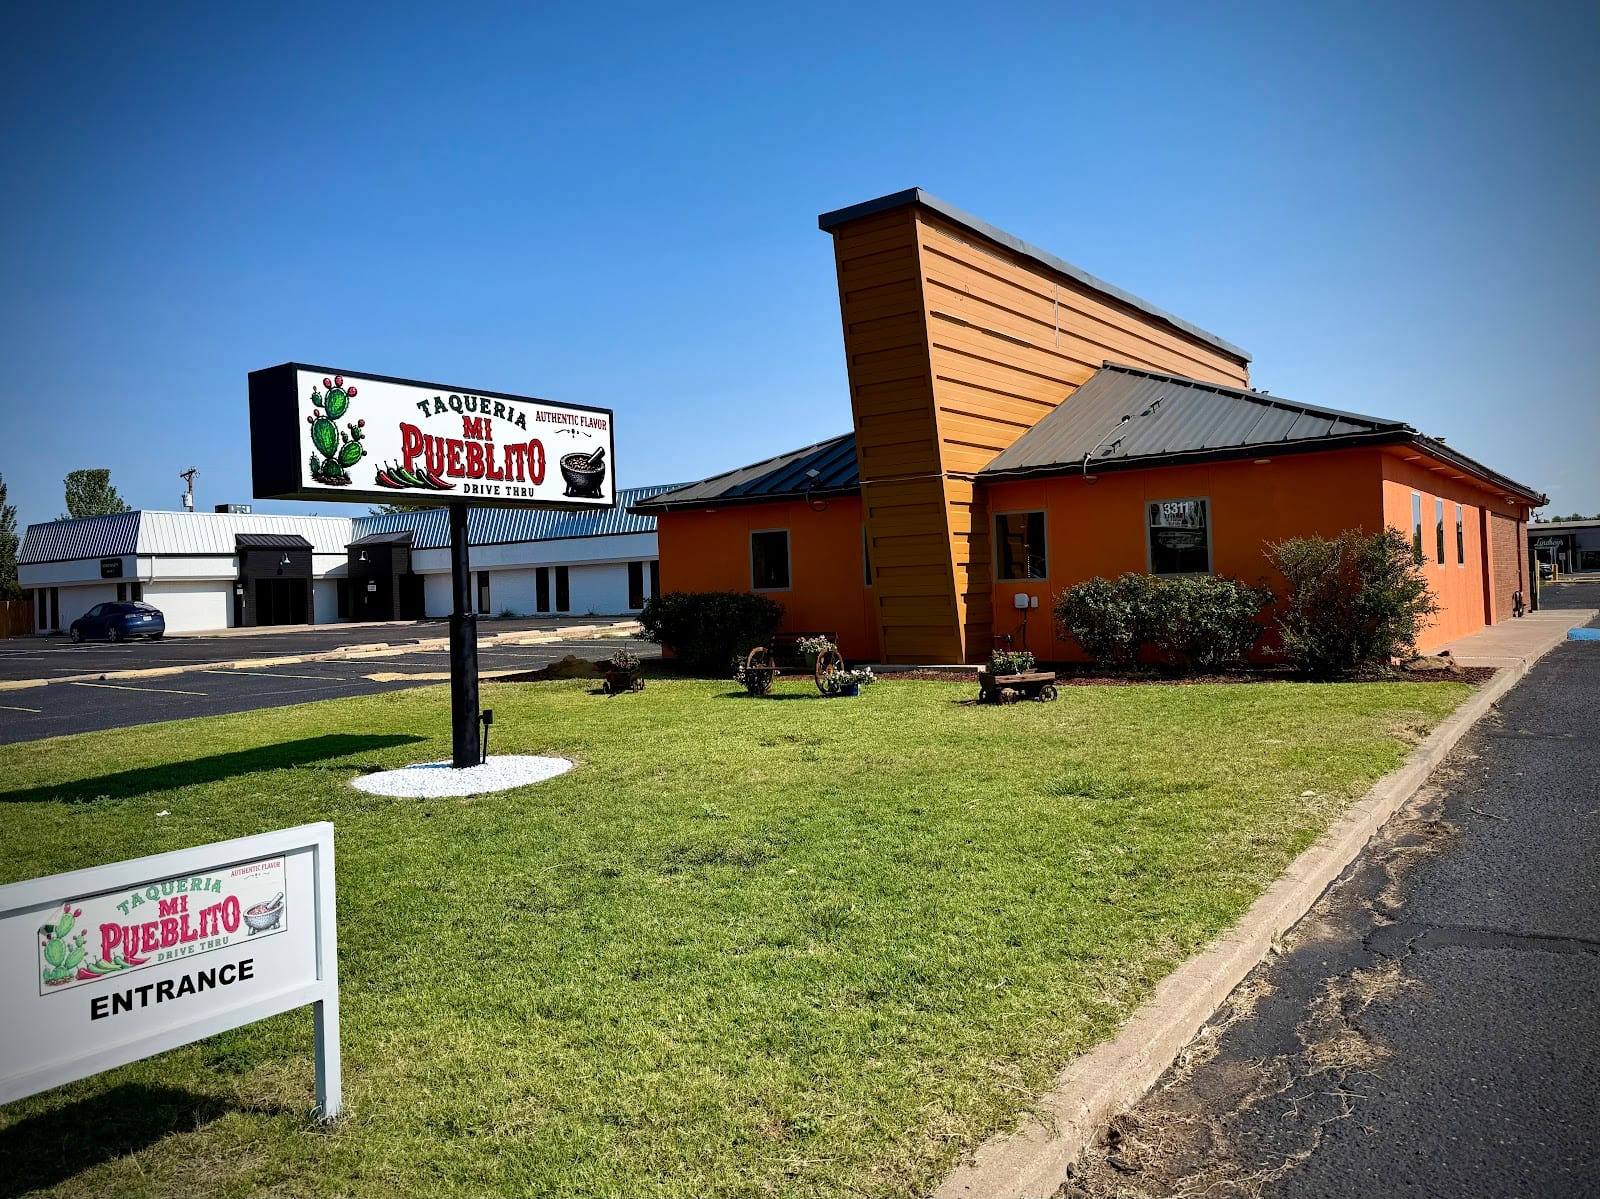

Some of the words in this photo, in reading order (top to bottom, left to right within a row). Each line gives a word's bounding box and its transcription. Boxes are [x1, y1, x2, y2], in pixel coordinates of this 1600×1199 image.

[416, 394, 526, 431] TAQUERIA
[535, 410, 579, 426] AUTHENTIC
[580, 416, 607, 431] FLAVOR
[462, 415, 492, 441] MI
[400, 422, 546, 485] PUEBLITO
[463, 483, 501, 496] DRIVE
[505, 486, 535, 498] THRU
[1163, 502, 1189, 515] 3311
[230, 864, 261, 878] AUTHENTIC
[116, 878, 222, 915] TAQUERIA
[159, 895, 188, 917] MI
[100, 895, 241, 963] PUEBLITO
[157, 944, 195, 962] DRIVE
[199, 936, 229, 951] THRU
[91, 959, 254, 1020] ENTRANCE
